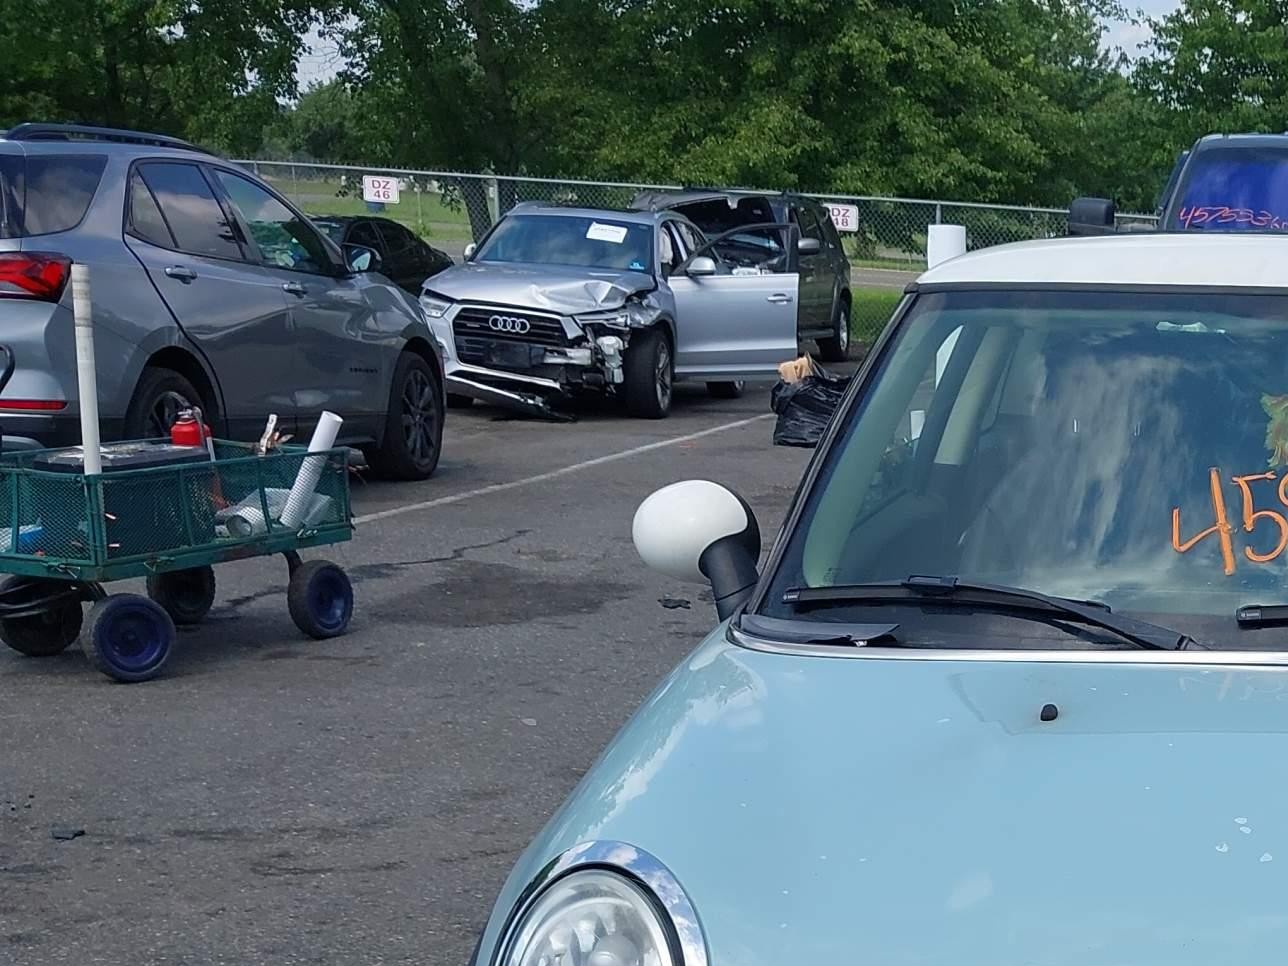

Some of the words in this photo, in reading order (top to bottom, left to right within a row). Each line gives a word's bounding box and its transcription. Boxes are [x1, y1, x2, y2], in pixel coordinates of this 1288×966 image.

[372, 180, 391, 190] DZ
[374, 190, 390, 200] 46
[831, 207, 850, 218] DZ
